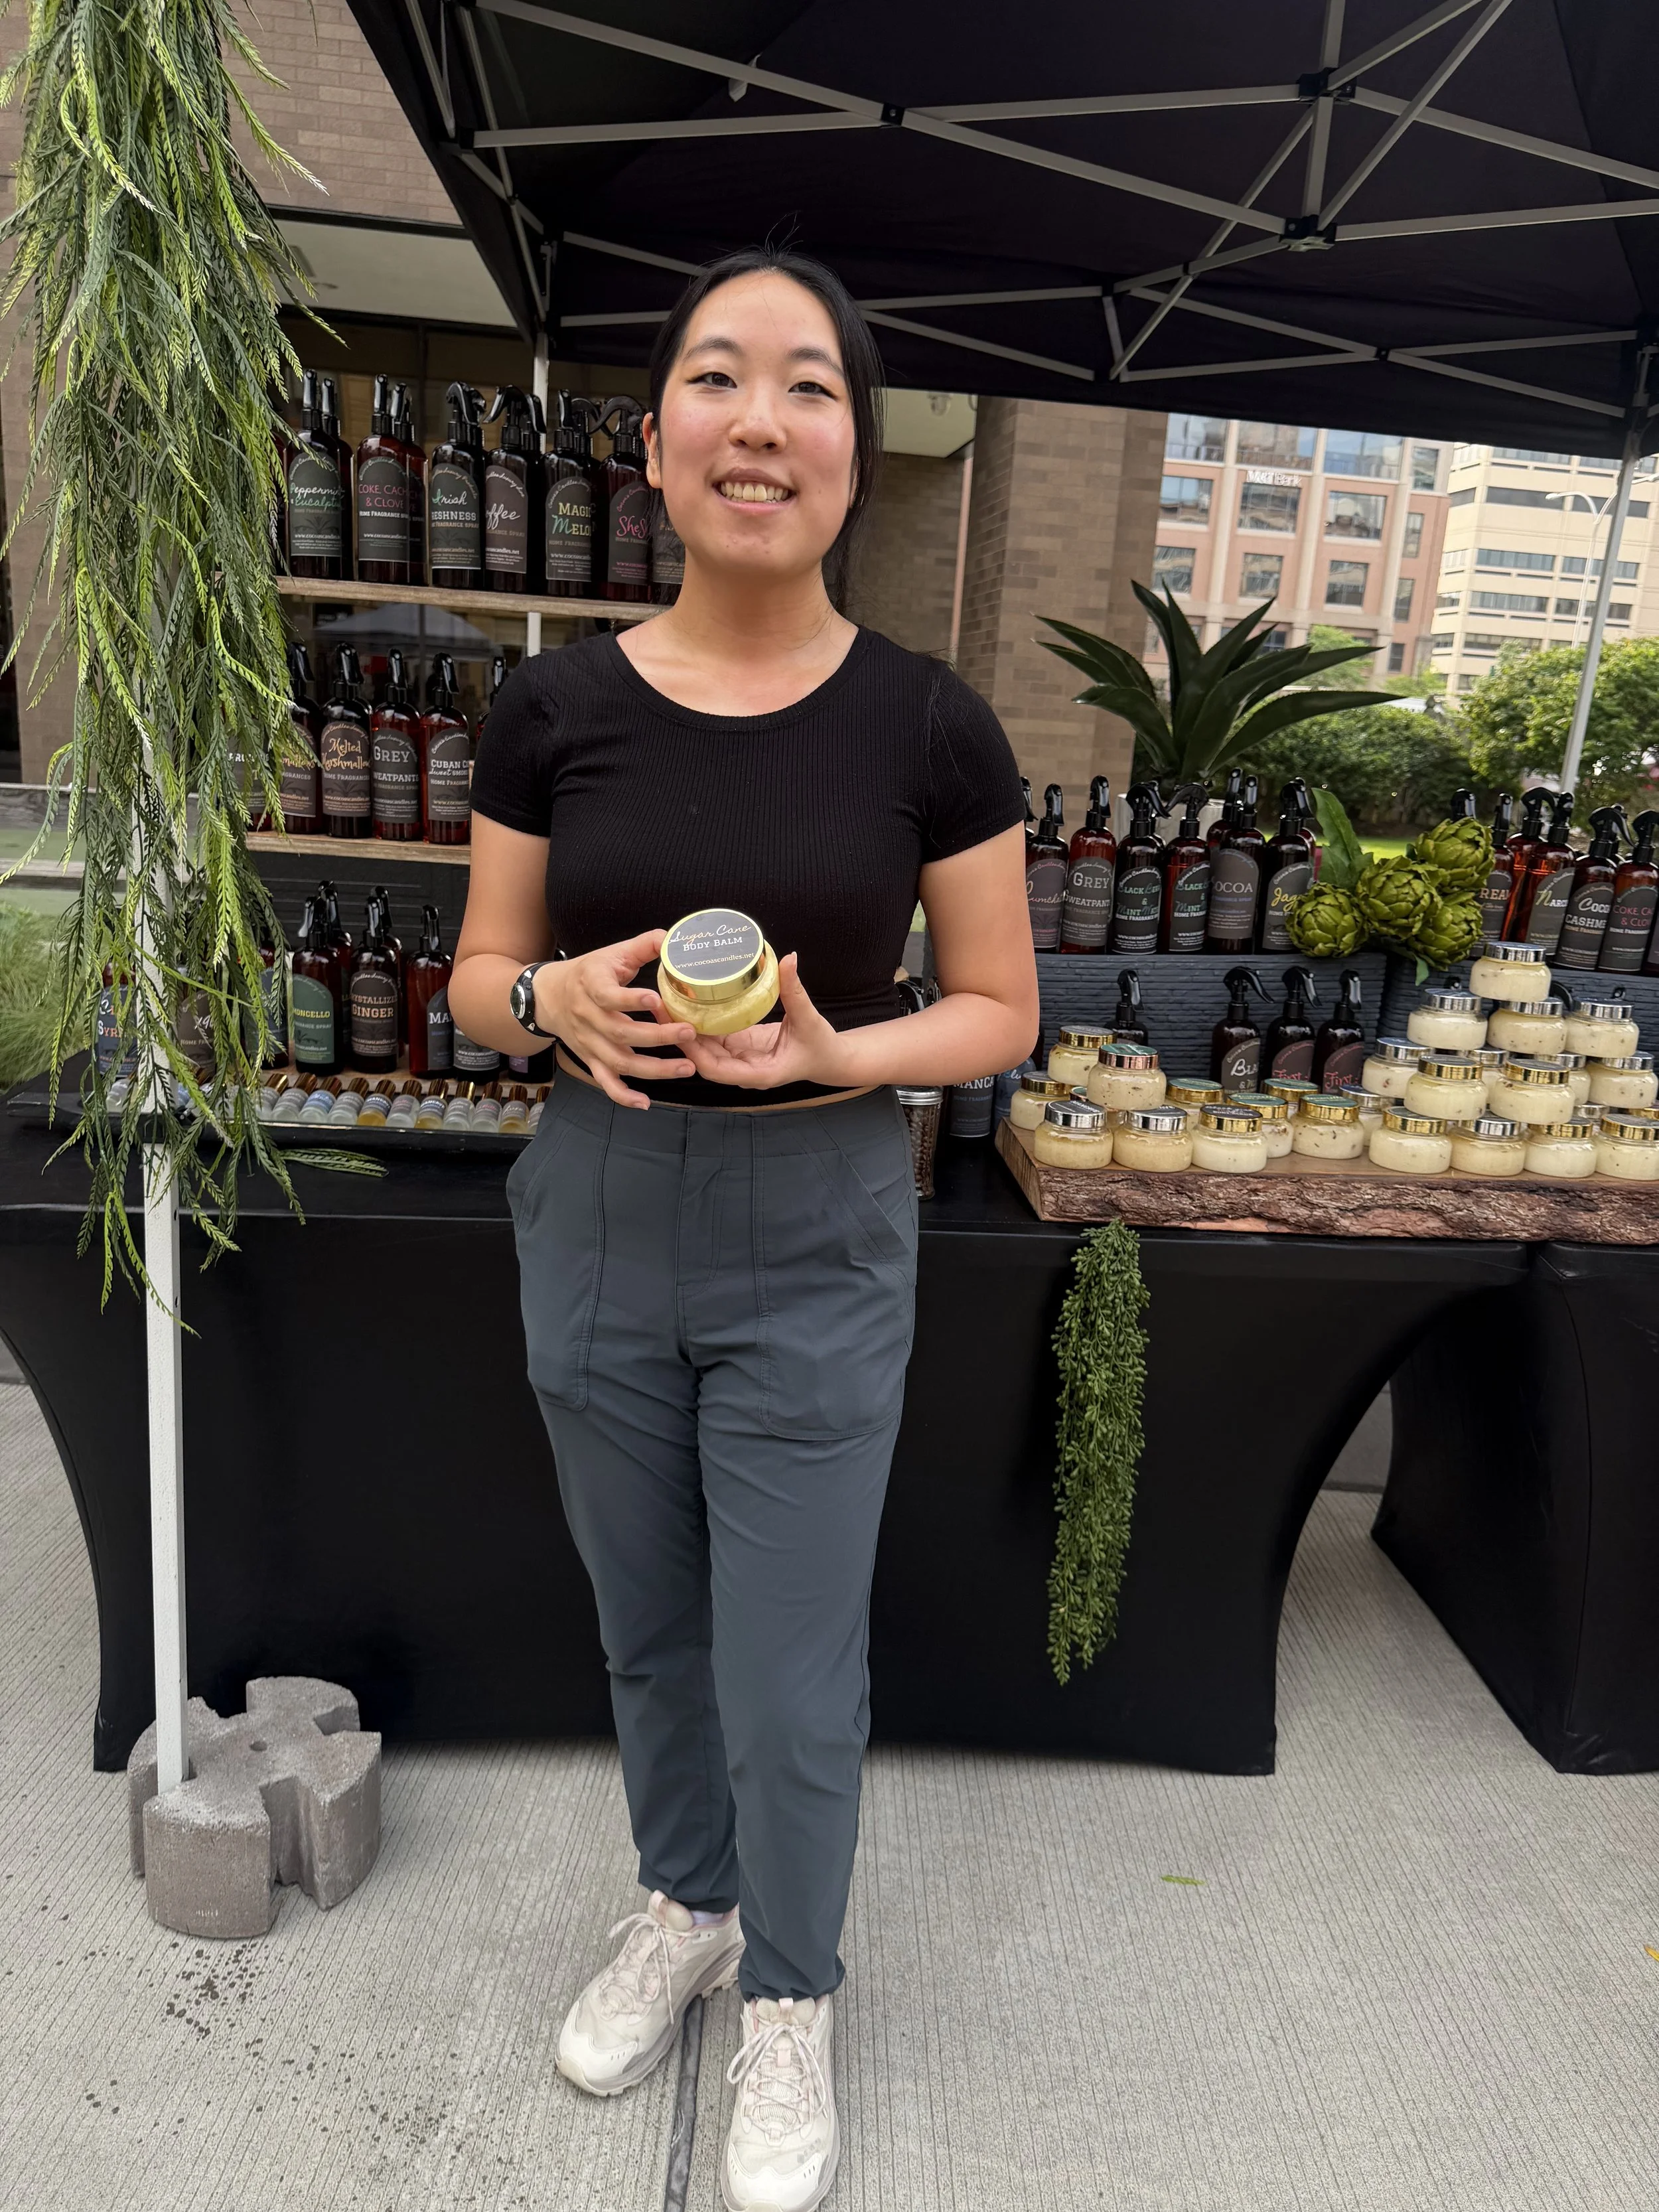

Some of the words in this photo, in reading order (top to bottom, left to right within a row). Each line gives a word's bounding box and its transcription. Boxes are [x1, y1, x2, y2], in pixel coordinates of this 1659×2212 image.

[366, 498, 372, 507] &
[374, 498, 404, 509] CLOVE
[329, 738, 361, 756] Melted
[374, 746, 410, 763] GREY
[431, 759, 461, 769] CUBAN
[1073, 872, 1110, 889] GREY
[1613, 905, 1638, 915] COKE
[1621, 917, 1627, 926] &
[669, 930, 715, 946] Sugar
[682, 941, 711, 952] BODY
[713, 936, 743, 947] BALM
[674, 952, 755, 969] www.cocoascandles.net
[352, 1004, 394, 1019] GINGER
[1239, 1080, 1246, 1089] &
